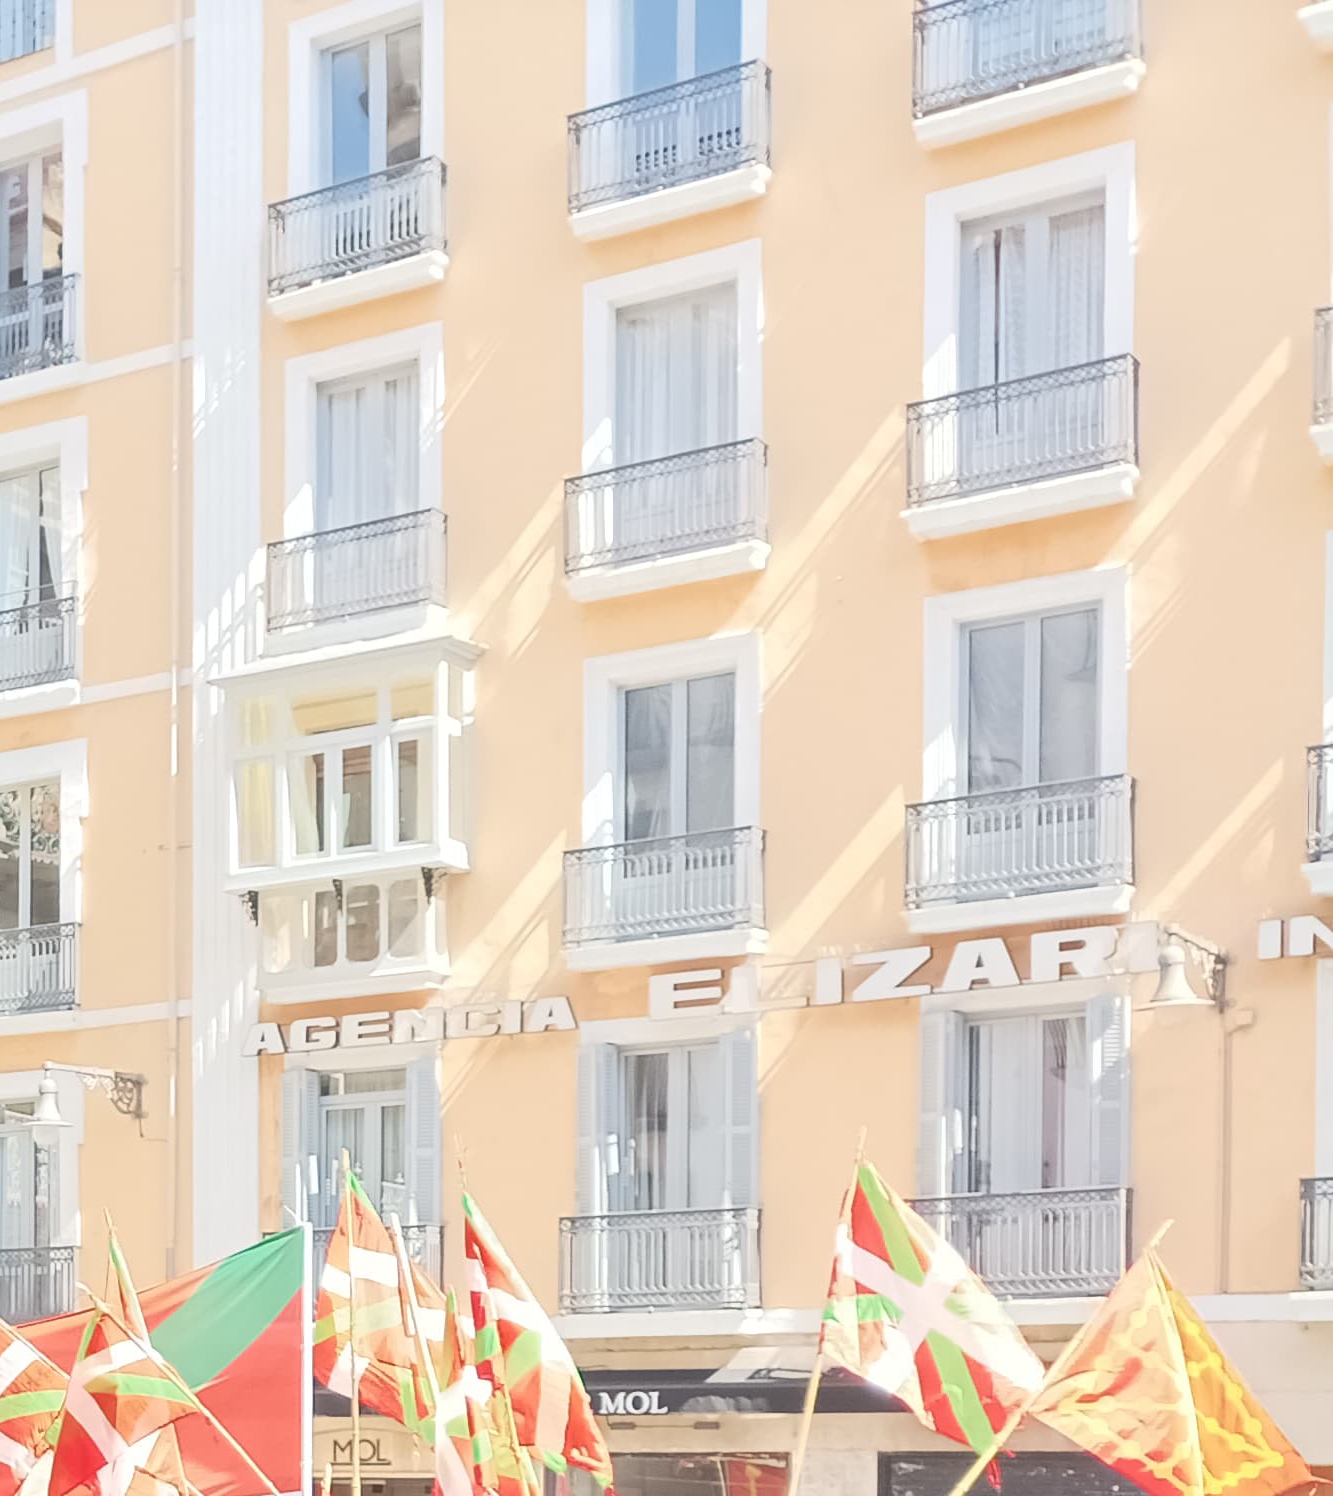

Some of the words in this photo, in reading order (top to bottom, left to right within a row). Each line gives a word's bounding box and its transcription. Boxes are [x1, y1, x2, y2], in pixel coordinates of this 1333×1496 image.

[241, 996, 579, 1058] AGENCIA
[598, 1391, 669, 1415] MOL
[333, 1438, 389, 1464] MOL
